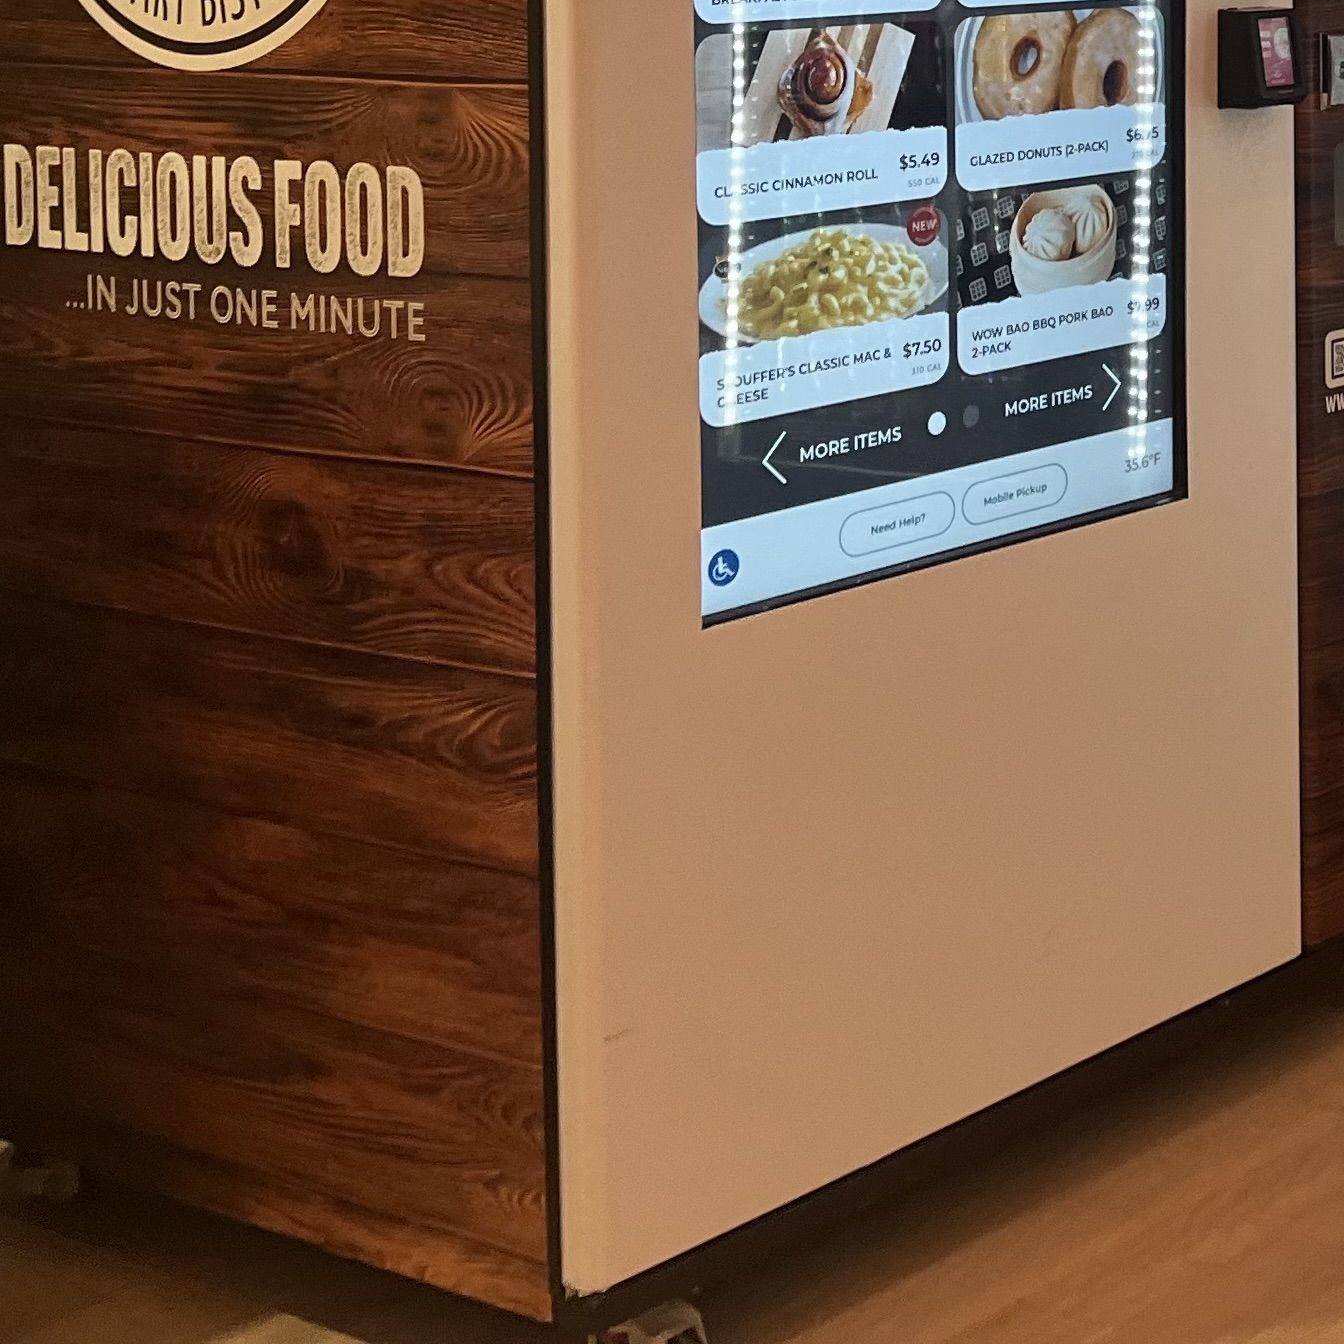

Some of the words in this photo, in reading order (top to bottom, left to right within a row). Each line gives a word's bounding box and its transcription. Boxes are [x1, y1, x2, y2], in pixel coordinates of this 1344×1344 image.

[899, 152, 940, 171] $5.49
[969, 151, 1015, 167] GLAZED
[1017, 145, 1063, 161] DONUTS
[1065, 140, 1109, 157] (2-PACK)
[714, 179, 769, 198] CLSSIC
[772, 173, 844, 192] CINNAMON
[846, 167, 879, 182] ROLL
[3, 143, 263, 267] DELICIOUS
[274, 160, 425, 278] FOOD
[911, 218, 938, 233] NEW
[125, 278, 202, 320] JUST
[210, 285, 279, 329] ONE
[291, 292, 427, 342] MINUTE
[972, 328, 1003, 342] WOW
[1006, 324, 1030, 337] BAO
[1032, 319, 1056, 332] BBQ
[1058, 311, 1088, 327] PORK
[1090, 305, 1114, 319] BAO
[902, 337, 942, 359] $7.50
[971, 340, 1012, 359] 2-PACK
[716, 366, 796, 391] SOUFFER'S
[798, 354, 851, 376] CLASSIC
[853, 350, 882, 365] MAC
[883, 346, 892, 359] &
[716, 388, 769, 409] CEESE
[1004, 396, 1049, 417] MORE
[1051, 384, 1094, 407] ITEMS
[799, 434, 850, 463] MORE
[853, 426, 902, 451] ITEMS
[983, 492, 1014, 507] Mobile
[1016, 482, 1048, 499] Pickup
[870, 522, 897, 536] Need
[899, 512, 926, 532] Help?
